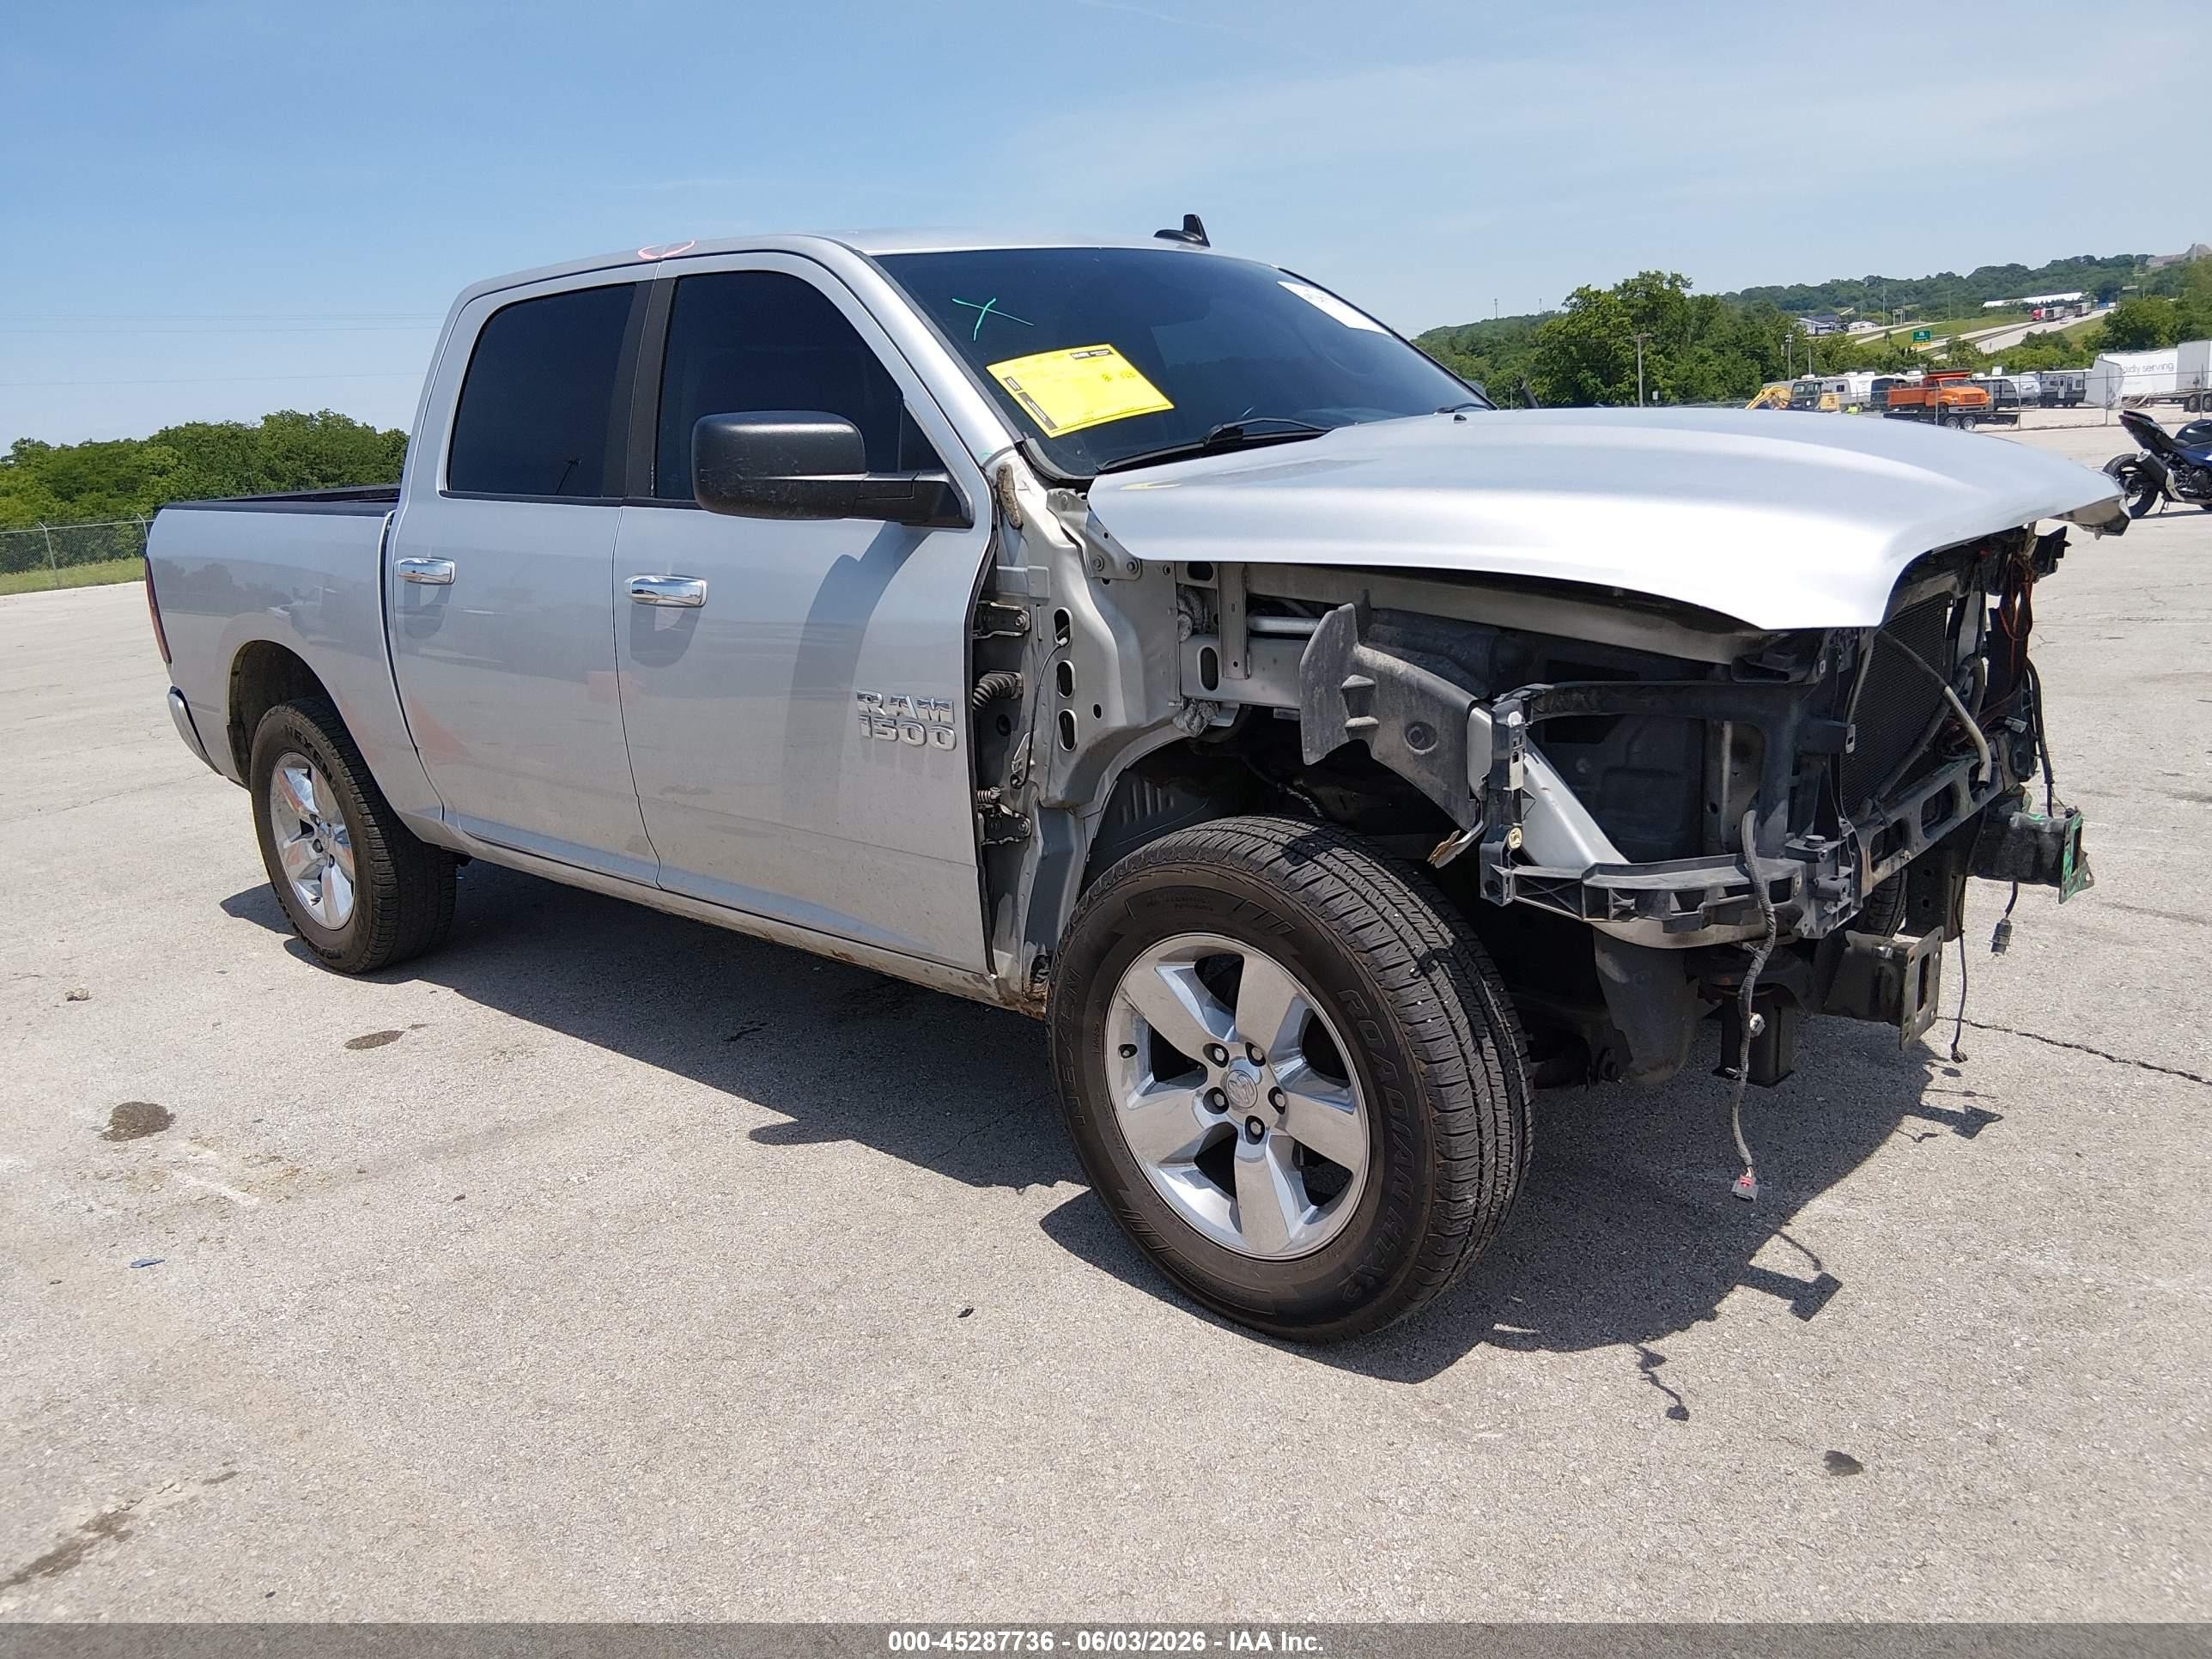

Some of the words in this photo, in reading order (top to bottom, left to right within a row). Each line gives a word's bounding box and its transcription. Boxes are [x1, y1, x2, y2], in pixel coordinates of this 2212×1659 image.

[2142, 362, 2174, 373] serving
[856, 690, 955, 724] RAM
[859, 715, 957, 751] 1500
[1337, 988, 1418, 1209] ROADIAN
